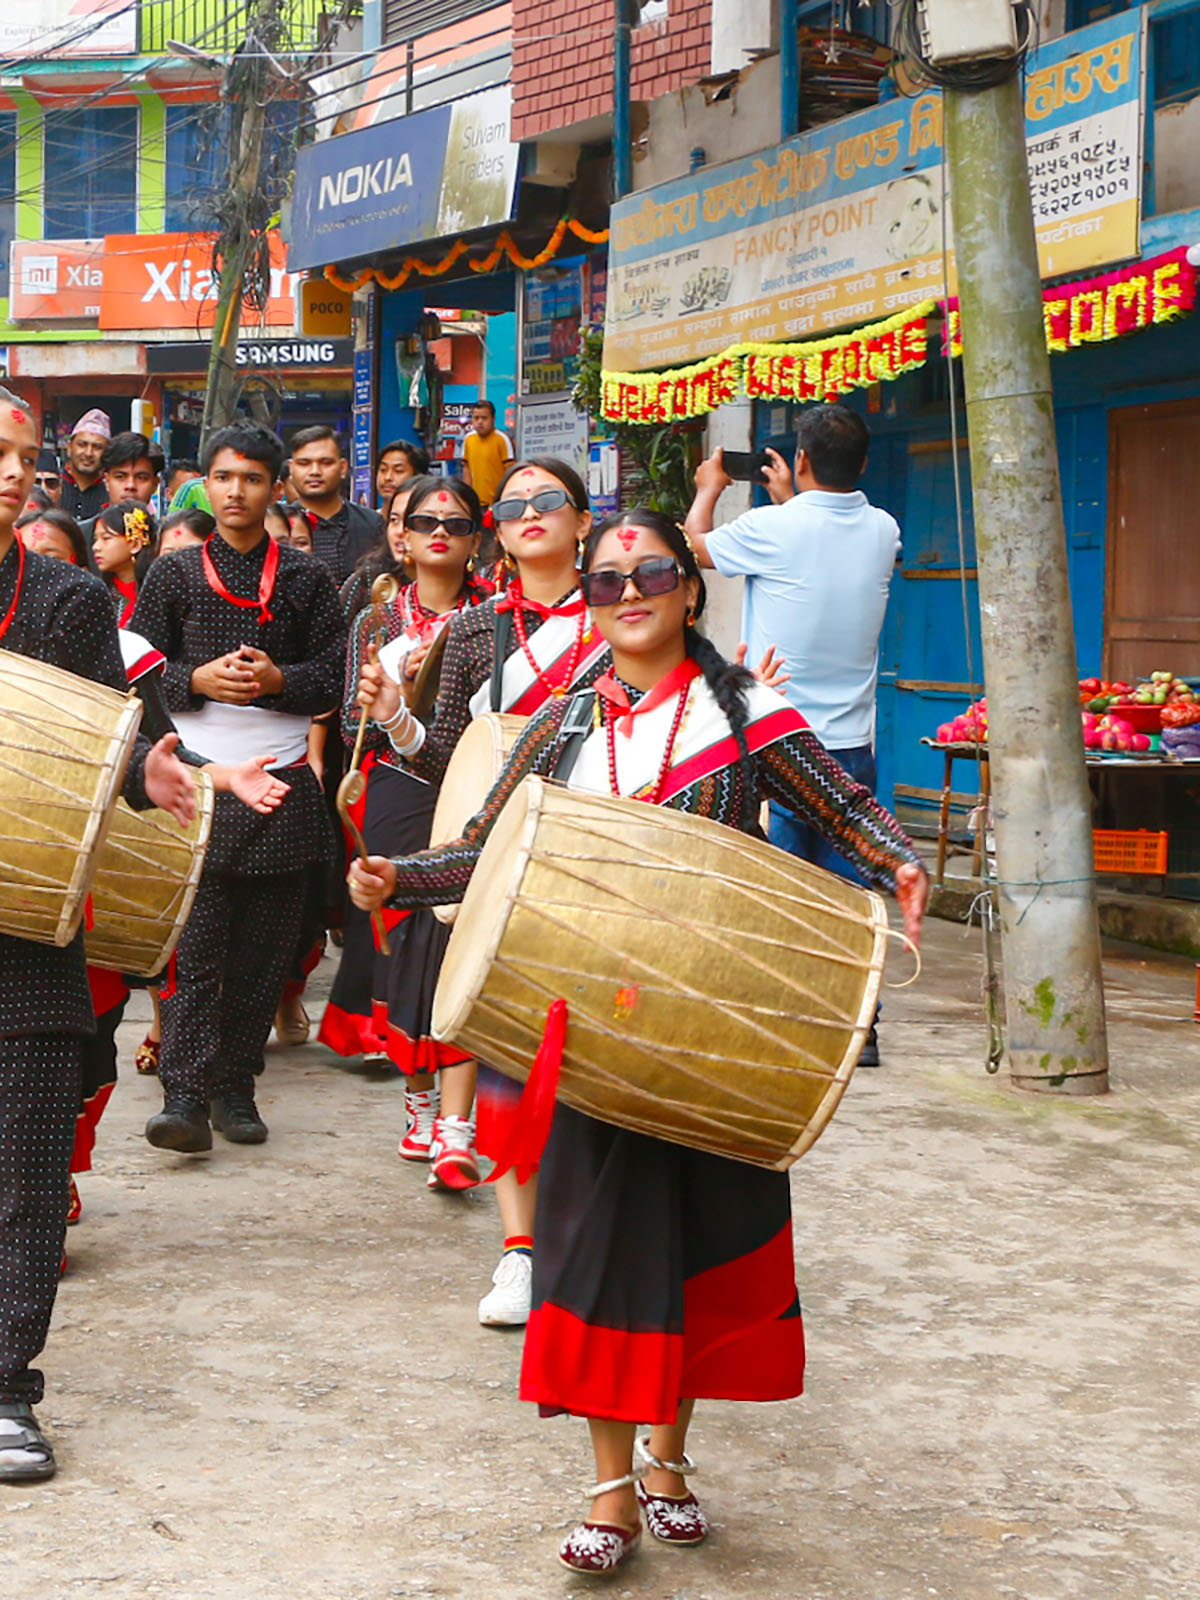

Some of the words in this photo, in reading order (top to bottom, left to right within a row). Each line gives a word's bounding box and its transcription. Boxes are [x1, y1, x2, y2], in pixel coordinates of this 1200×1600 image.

[835, 120, 904, 179] एण्ड
[910, 94, 943, 157] गि
[1025, 32, 1136, 121] हाउस
[463, 121, 506, 149] Suvam
[1026, 132, 1062, 156] म्पर्क
[318, 152, 414, 211] NOKIA
[458, 153, 504, 182] Traders
[733, 217, 804, 265] FANCY
[807, 197, 879, 243] POINT
[65, 263, 104, 288] Xia
[141, 258, 308, 303] Xiam
[883, 258, 944, 288] ब्राडेड
[309, 301, 344, 315] POCO
[235, 343, 336, 365] SAMSUNG
[443, 405, 473, 417] Sale
